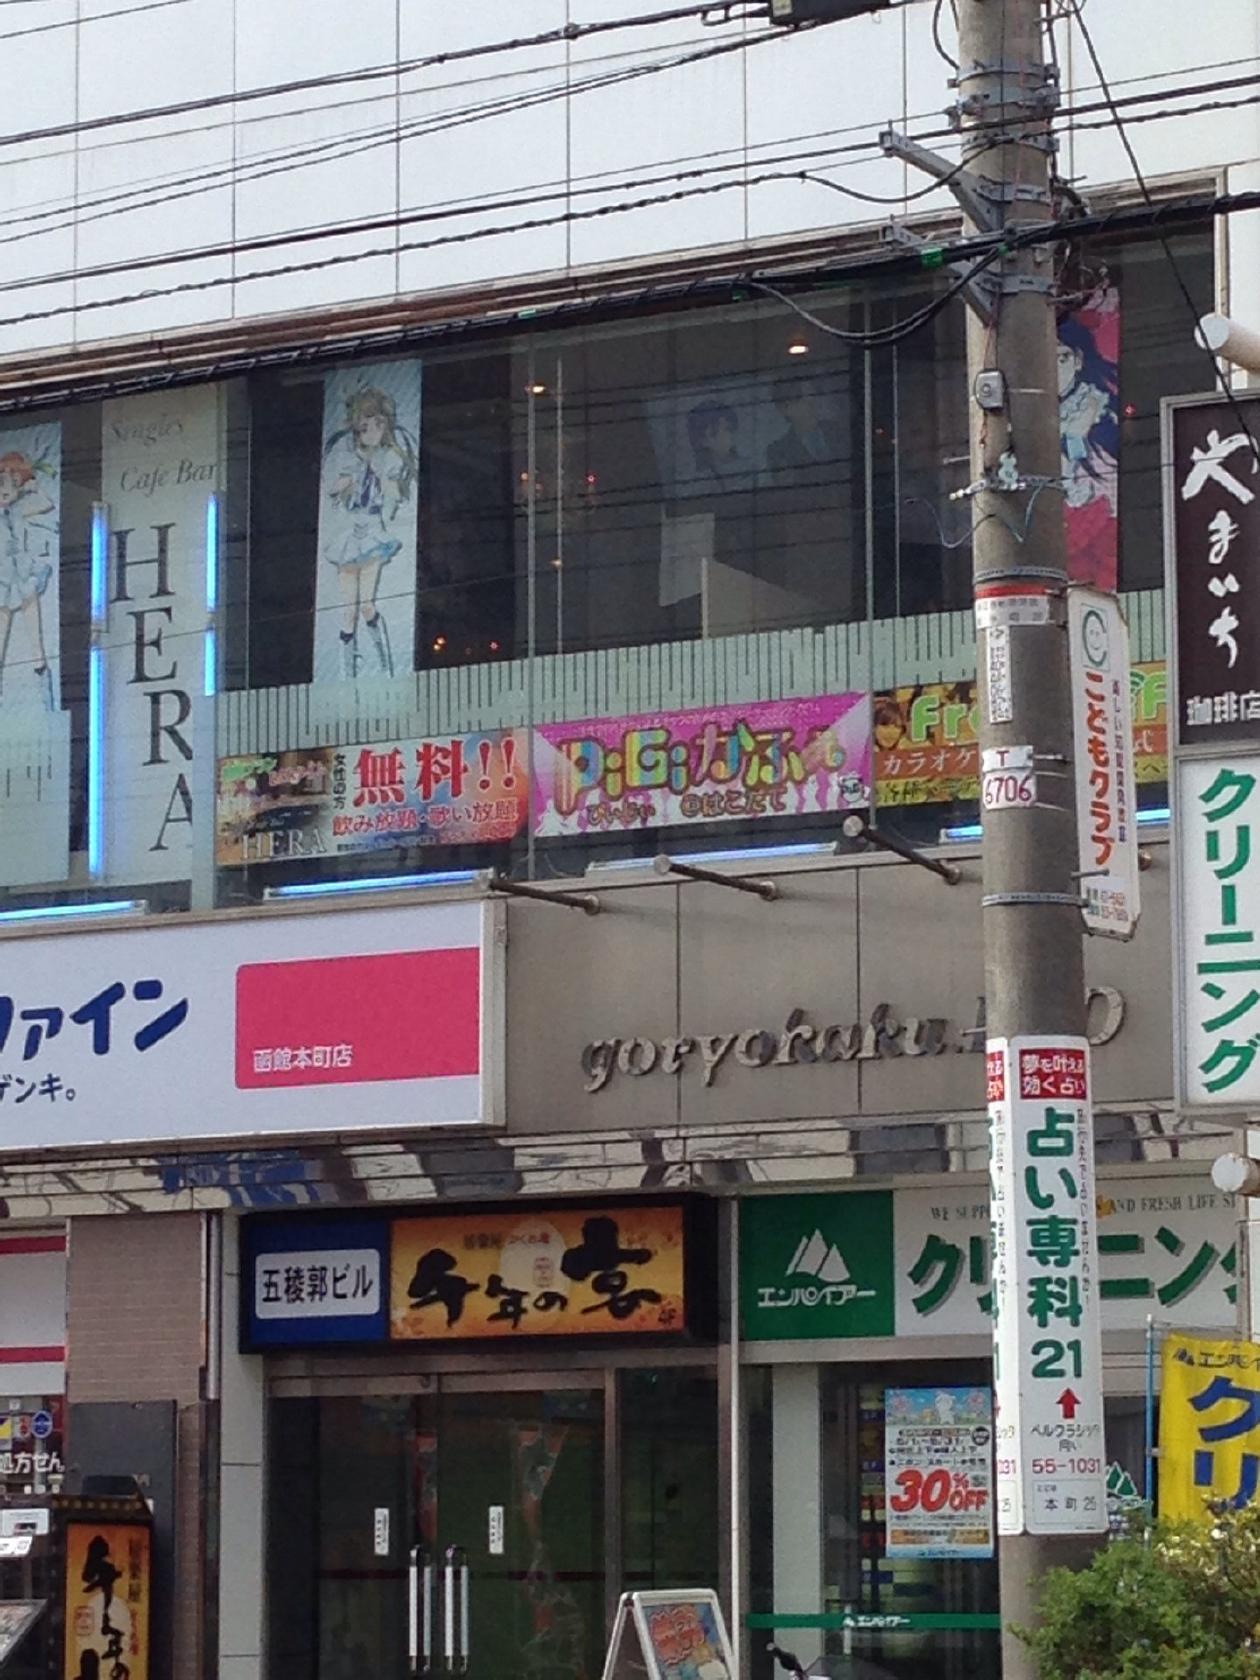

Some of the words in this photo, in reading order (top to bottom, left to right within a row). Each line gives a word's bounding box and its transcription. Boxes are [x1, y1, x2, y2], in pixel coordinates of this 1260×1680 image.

[176, 458, 217, 485] Bar
[112, 521, 193, 852] HERA
[253, 1043, 353, 1073] 函館本町店
[261, 1264, 373, 1305] 五稜郭ビル
[407, 1216, 662, 1330] 千年の宴
